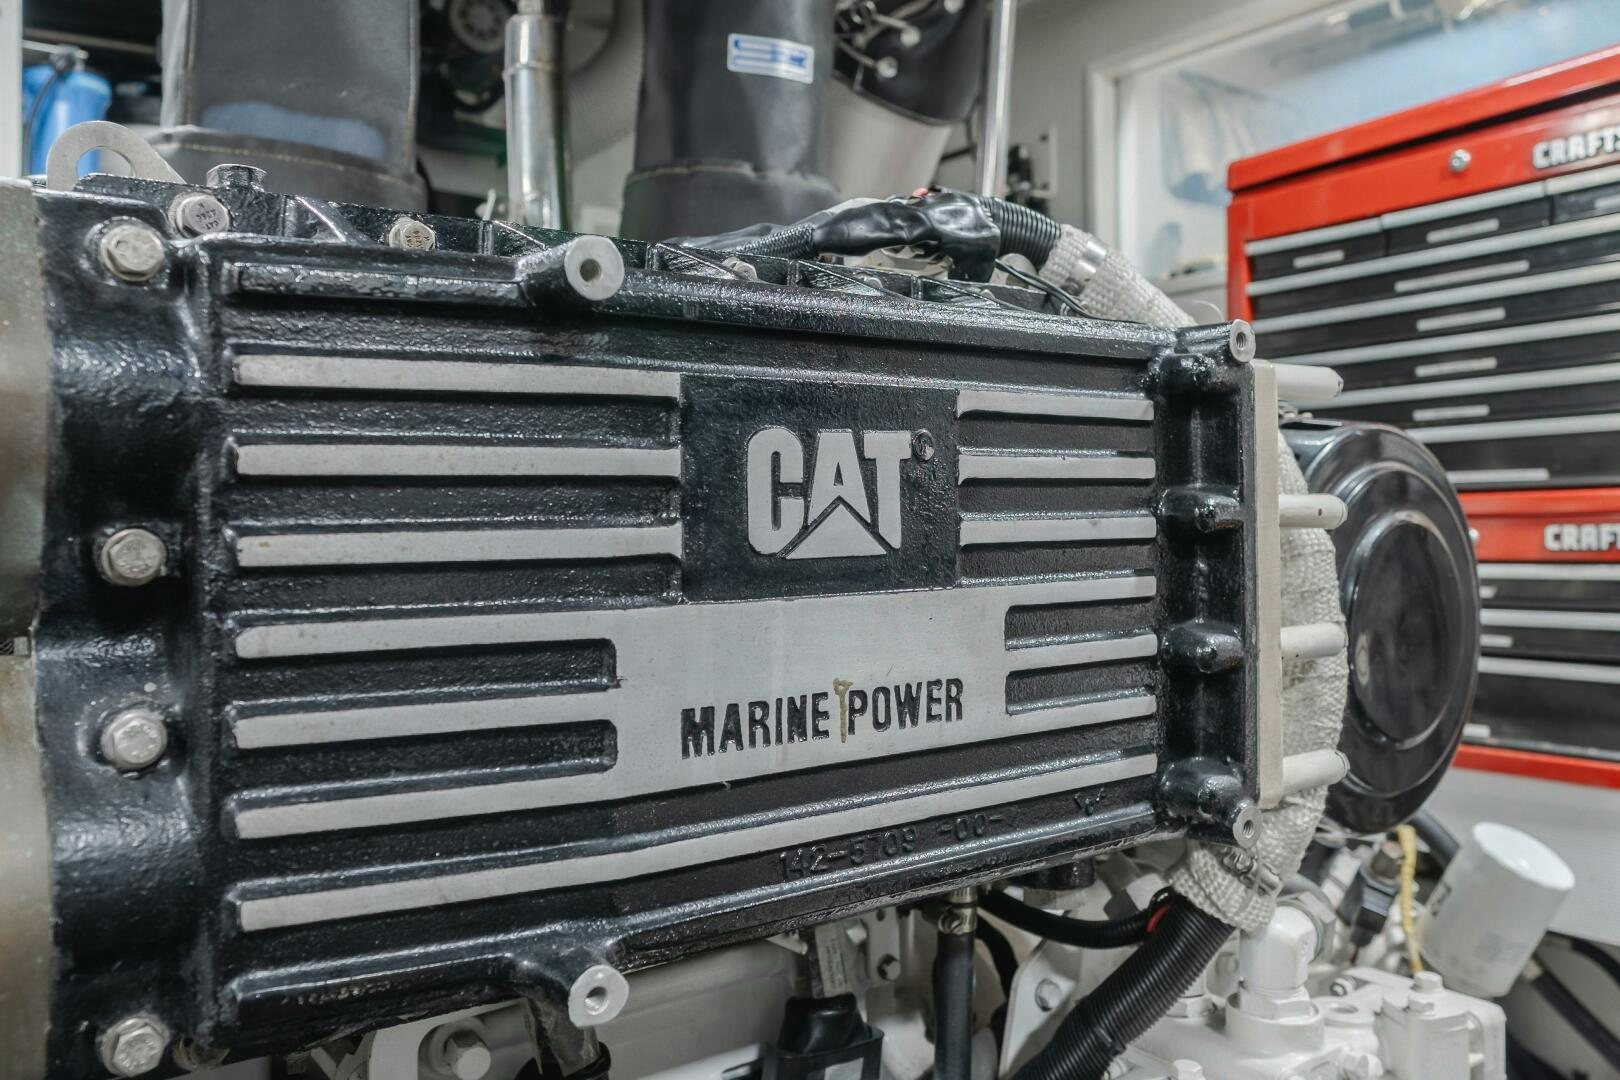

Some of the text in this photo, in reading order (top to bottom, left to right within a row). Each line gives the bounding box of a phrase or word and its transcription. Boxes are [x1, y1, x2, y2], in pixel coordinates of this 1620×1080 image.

[746, 426, 911, 557] CAT
[1544, 523, 1620, 551] CRAF
[680, 678, 964, 760] MARINE POWER
